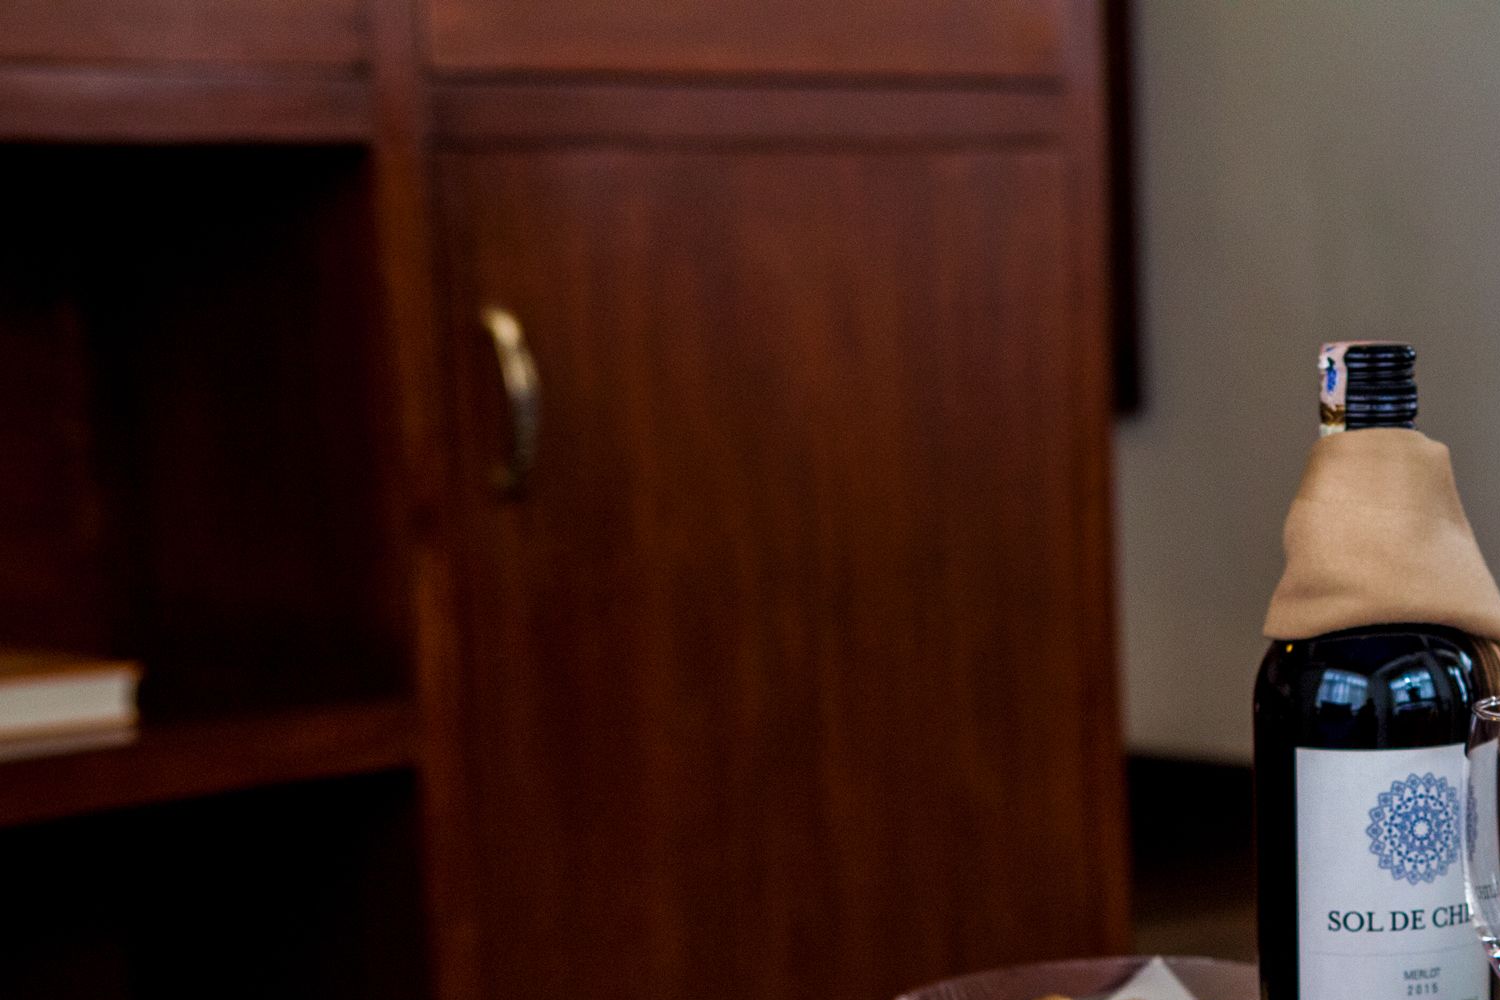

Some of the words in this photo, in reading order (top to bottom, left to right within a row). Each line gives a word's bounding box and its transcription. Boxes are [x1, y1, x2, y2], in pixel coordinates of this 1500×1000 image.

[1328, 910, 1384, 932] SOL
[1390, 909, 1426, 931] DE
[1432, 902, 1471, 928] CHI
[1403, 966, 1441, 980] MERLOT
[1407, 983, 1438, 996] 2015
